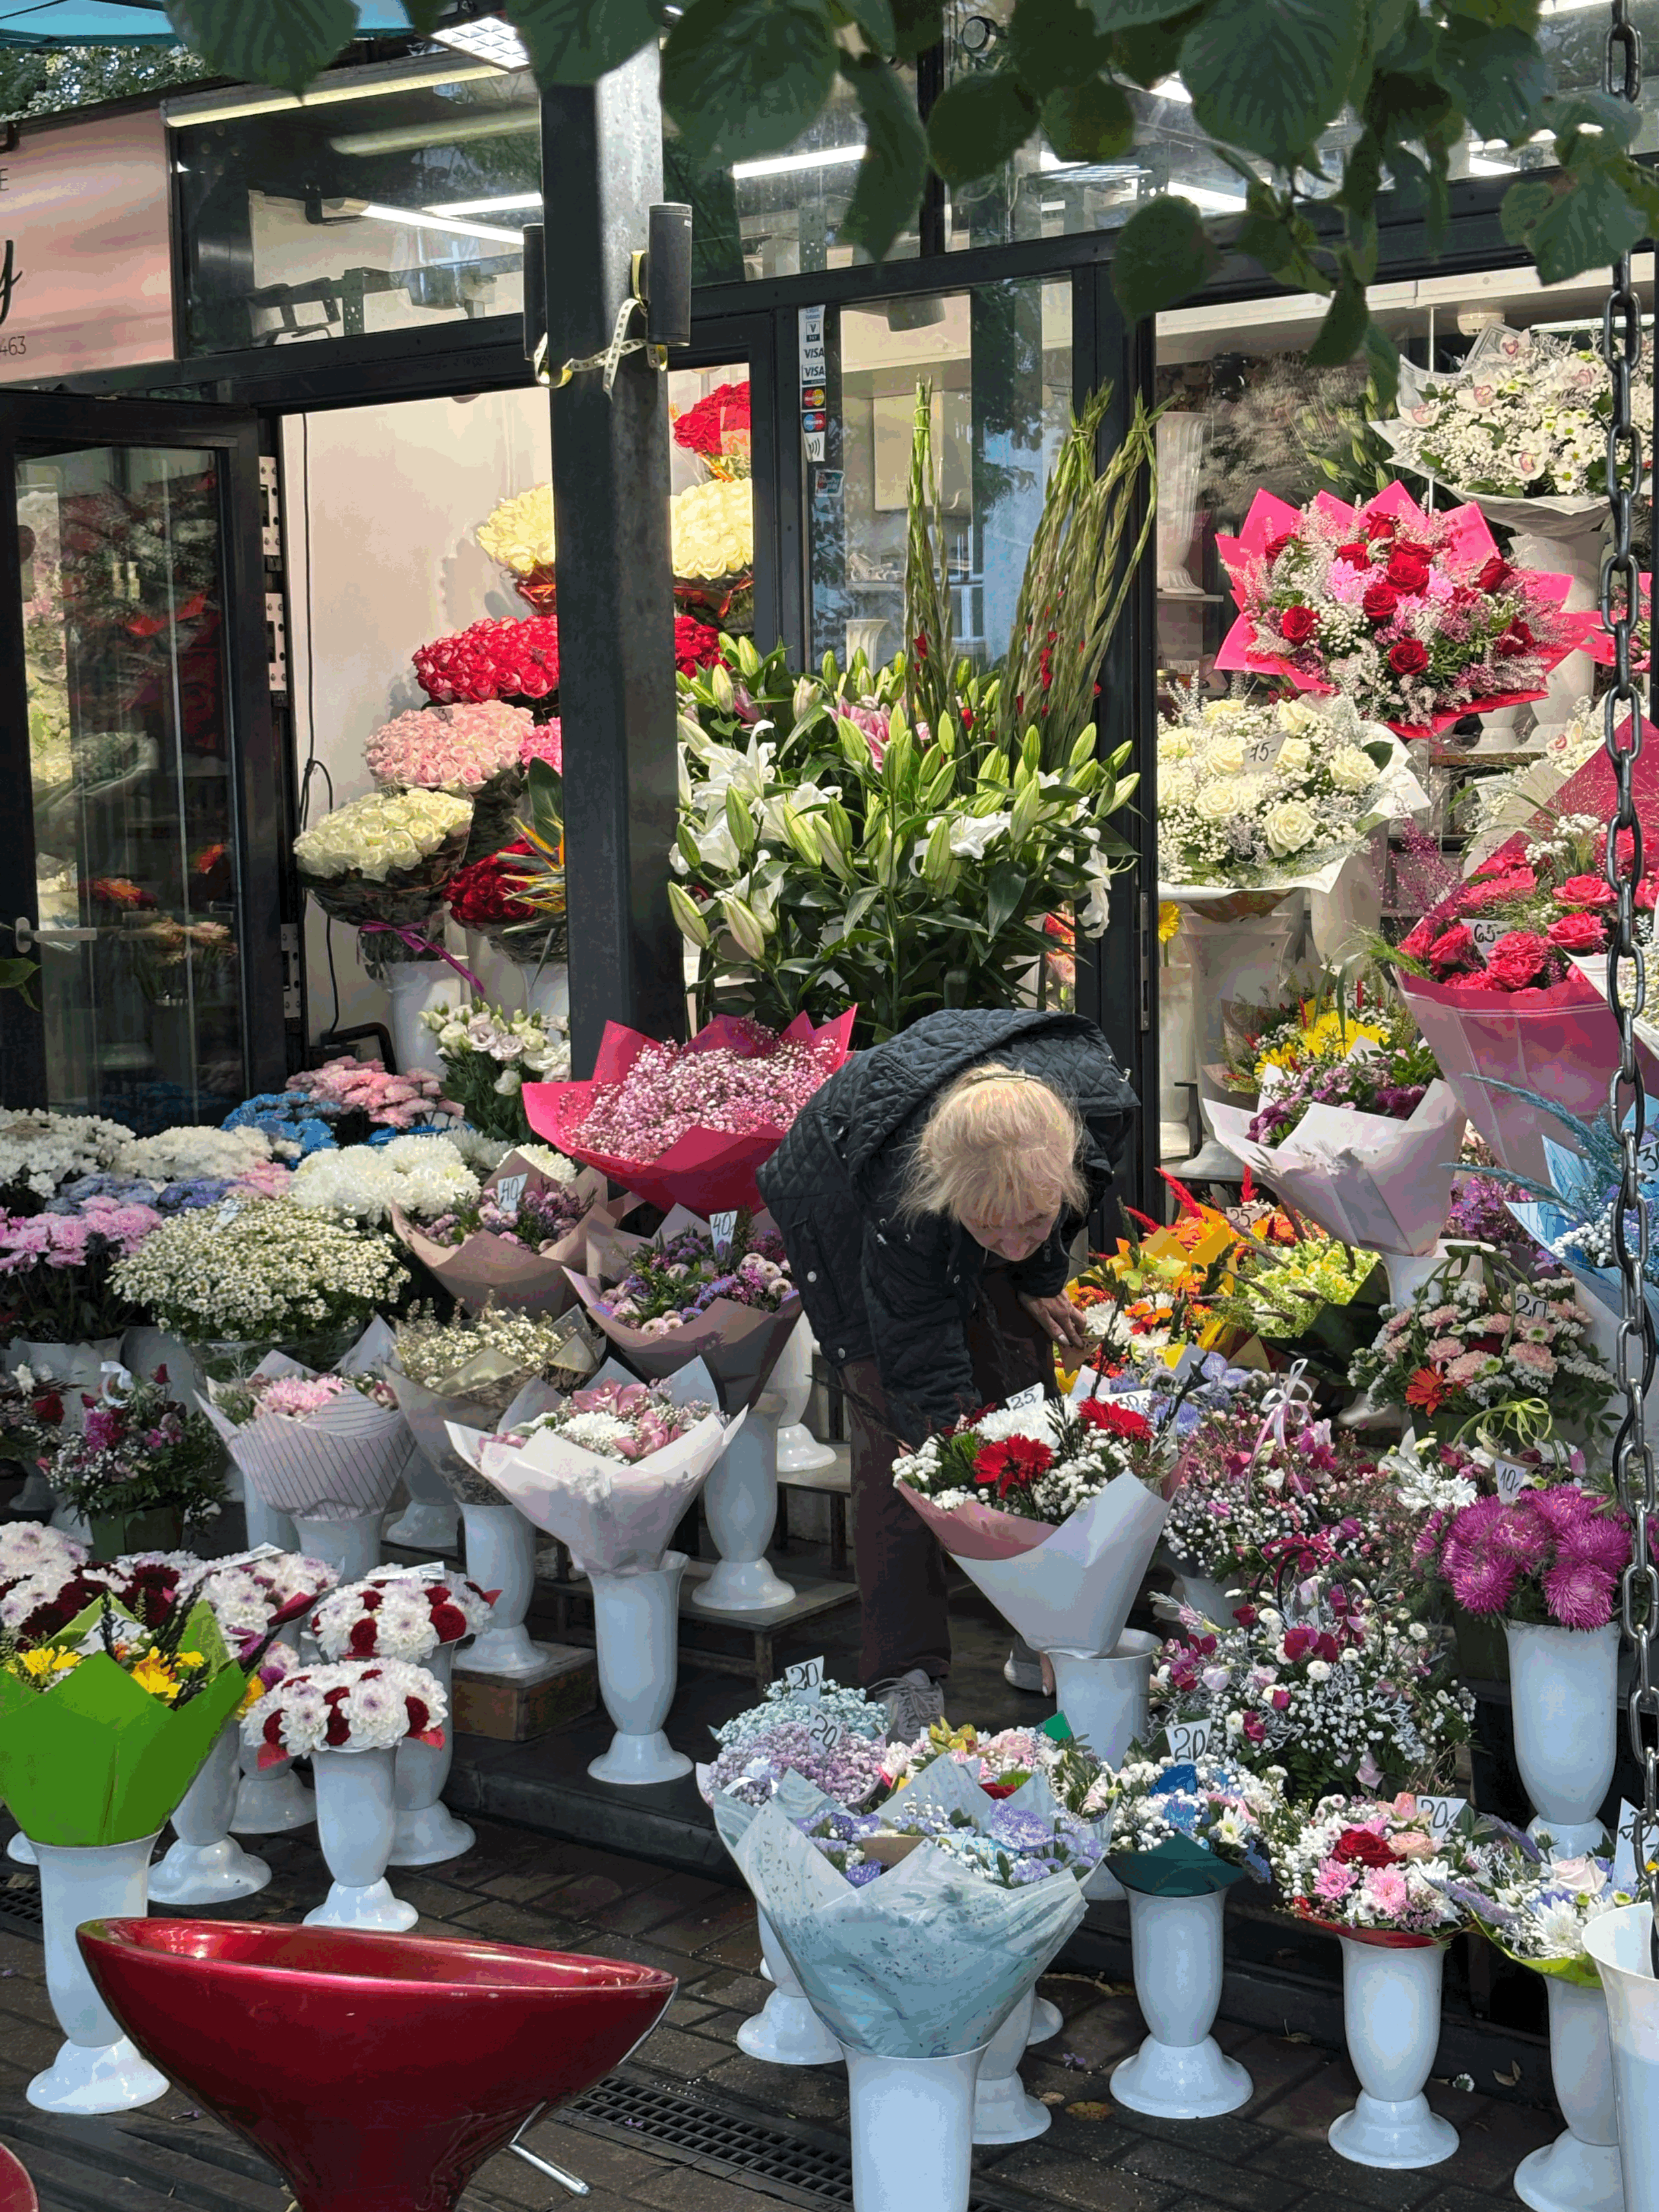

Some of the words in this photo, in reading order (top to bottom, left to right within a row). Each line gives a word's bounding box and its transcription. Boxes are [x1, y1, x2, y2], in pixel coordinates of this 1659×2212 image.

[804, 347, 825, 359] VISA
[804, 366, 825, 378] VISA
[790, 1662, 819, 1690] 20
[1174, 1727, 1206, 1762] 20
